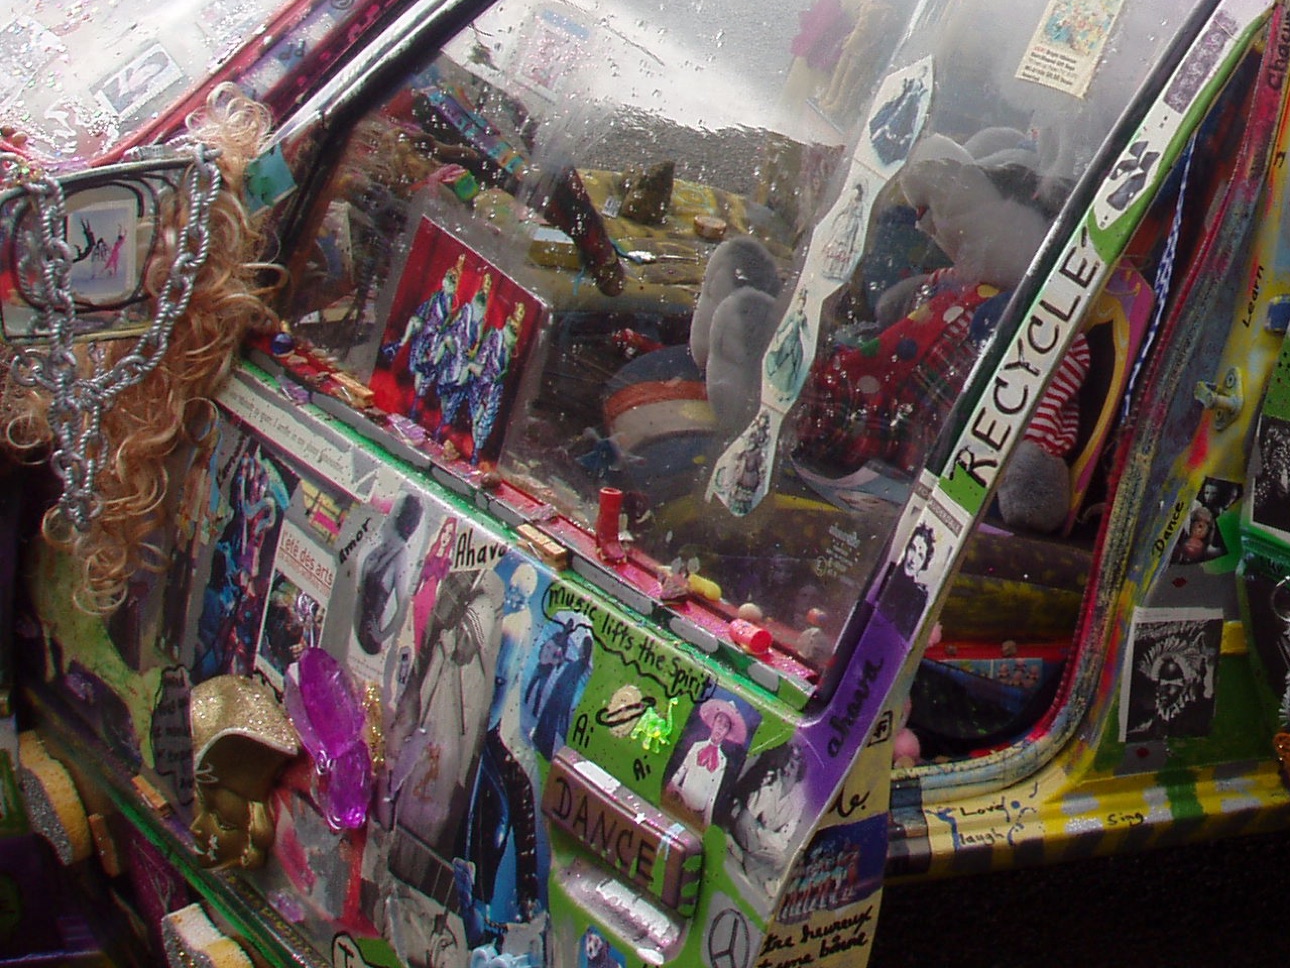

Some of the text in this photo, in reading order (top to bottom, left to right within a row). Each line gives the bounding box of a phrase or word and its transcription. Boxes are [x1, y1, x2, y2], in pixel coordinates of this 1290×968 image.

[601, 613, 635, 651] lifts
[639, 638, 666, 670] the
[572, 713, 595, 749] Ai
[827, 655, 885, 759] ahava
[632, 754, 652, 782] Ai
[552, 775, 657, 884] DANCE
